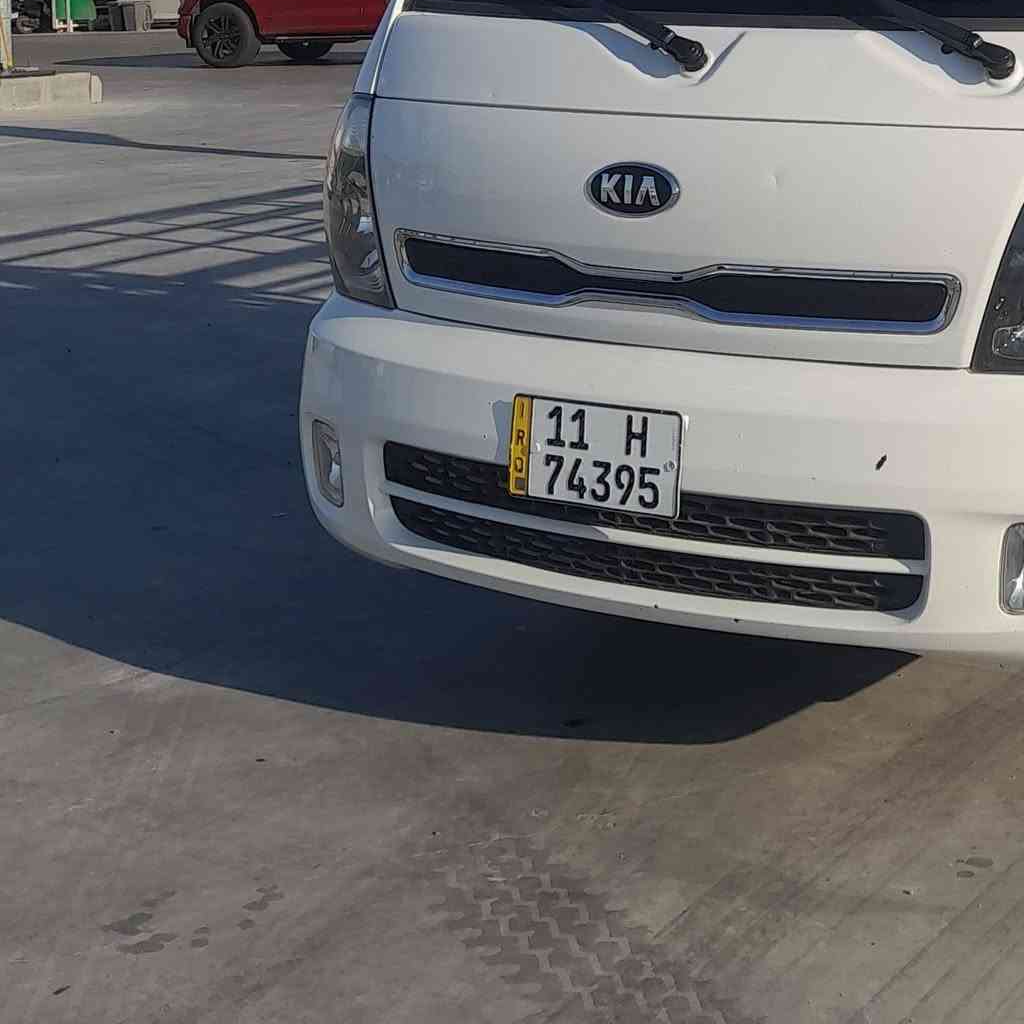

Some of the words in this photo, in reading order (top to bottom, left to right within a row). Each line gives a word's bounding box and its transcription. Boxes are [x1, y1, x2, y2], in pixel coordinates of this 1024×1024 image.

[600, 173, 660, 206] KIA
[546, 405, 589, 451] 11
[625, 414, 649, 458] H
[544, 453, 660, 510] 74395
